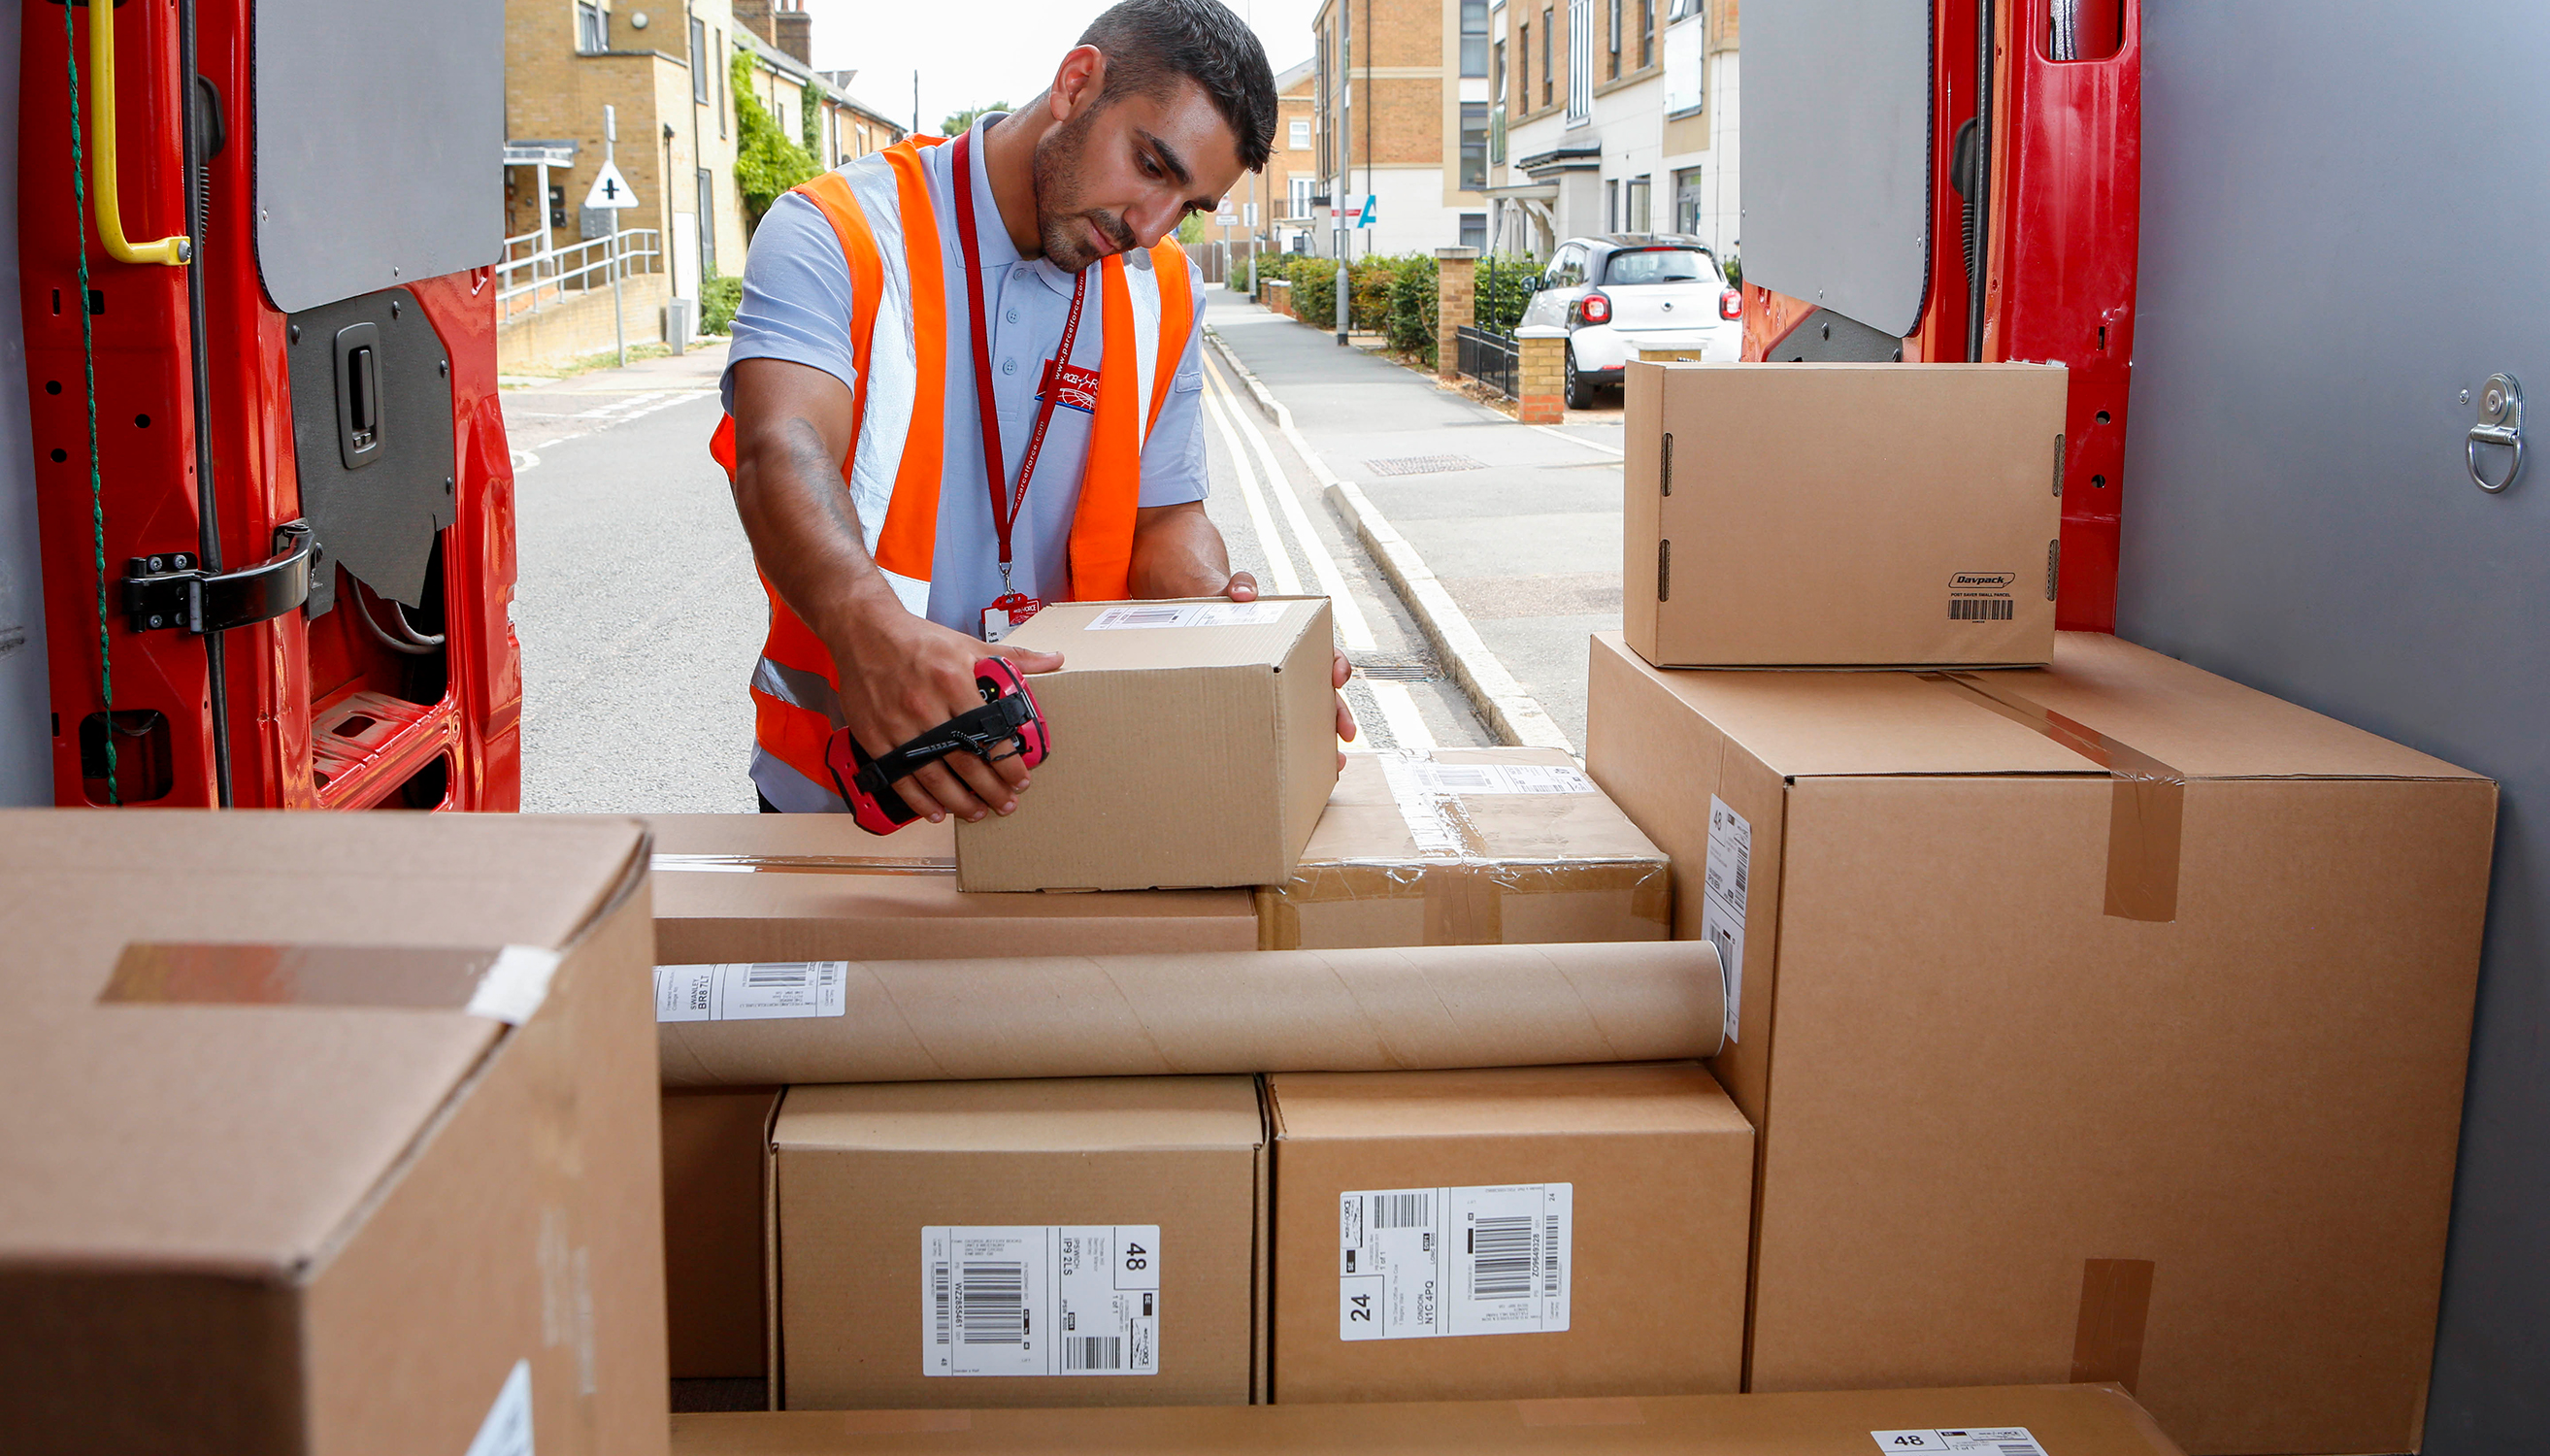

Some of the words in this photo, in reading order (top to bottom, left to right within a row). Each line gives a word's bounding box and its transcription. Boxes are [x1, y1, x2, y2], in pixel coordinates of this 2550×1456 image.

[1054, 276, 1084, 381] www.parcelforce.com
[1713, 810, 1722, 832] 48
[700, 976, 710, 988] 7LT
[690, 978, 699, 1010] SWANLEY
[698, 990, 708, 1009] BR8
[1549, 1193, 1555, 1202] 24
[1063, 1239, 1072, 1254] IP9
[1126, 1242, 1146, 1271] 48
[1379, 1256, 1386, 1265] of
[1425, 1280, 1434, 1301] 4PQ
[1144, 1295, 1151, 1306] SE
[1350, 1294, 1371, 1322] 24
[1425, 1304, 1434, 1324] N1C
[941, 1358, 947, 1367] 48
[1893, 1435, 1925, 1446] 48
